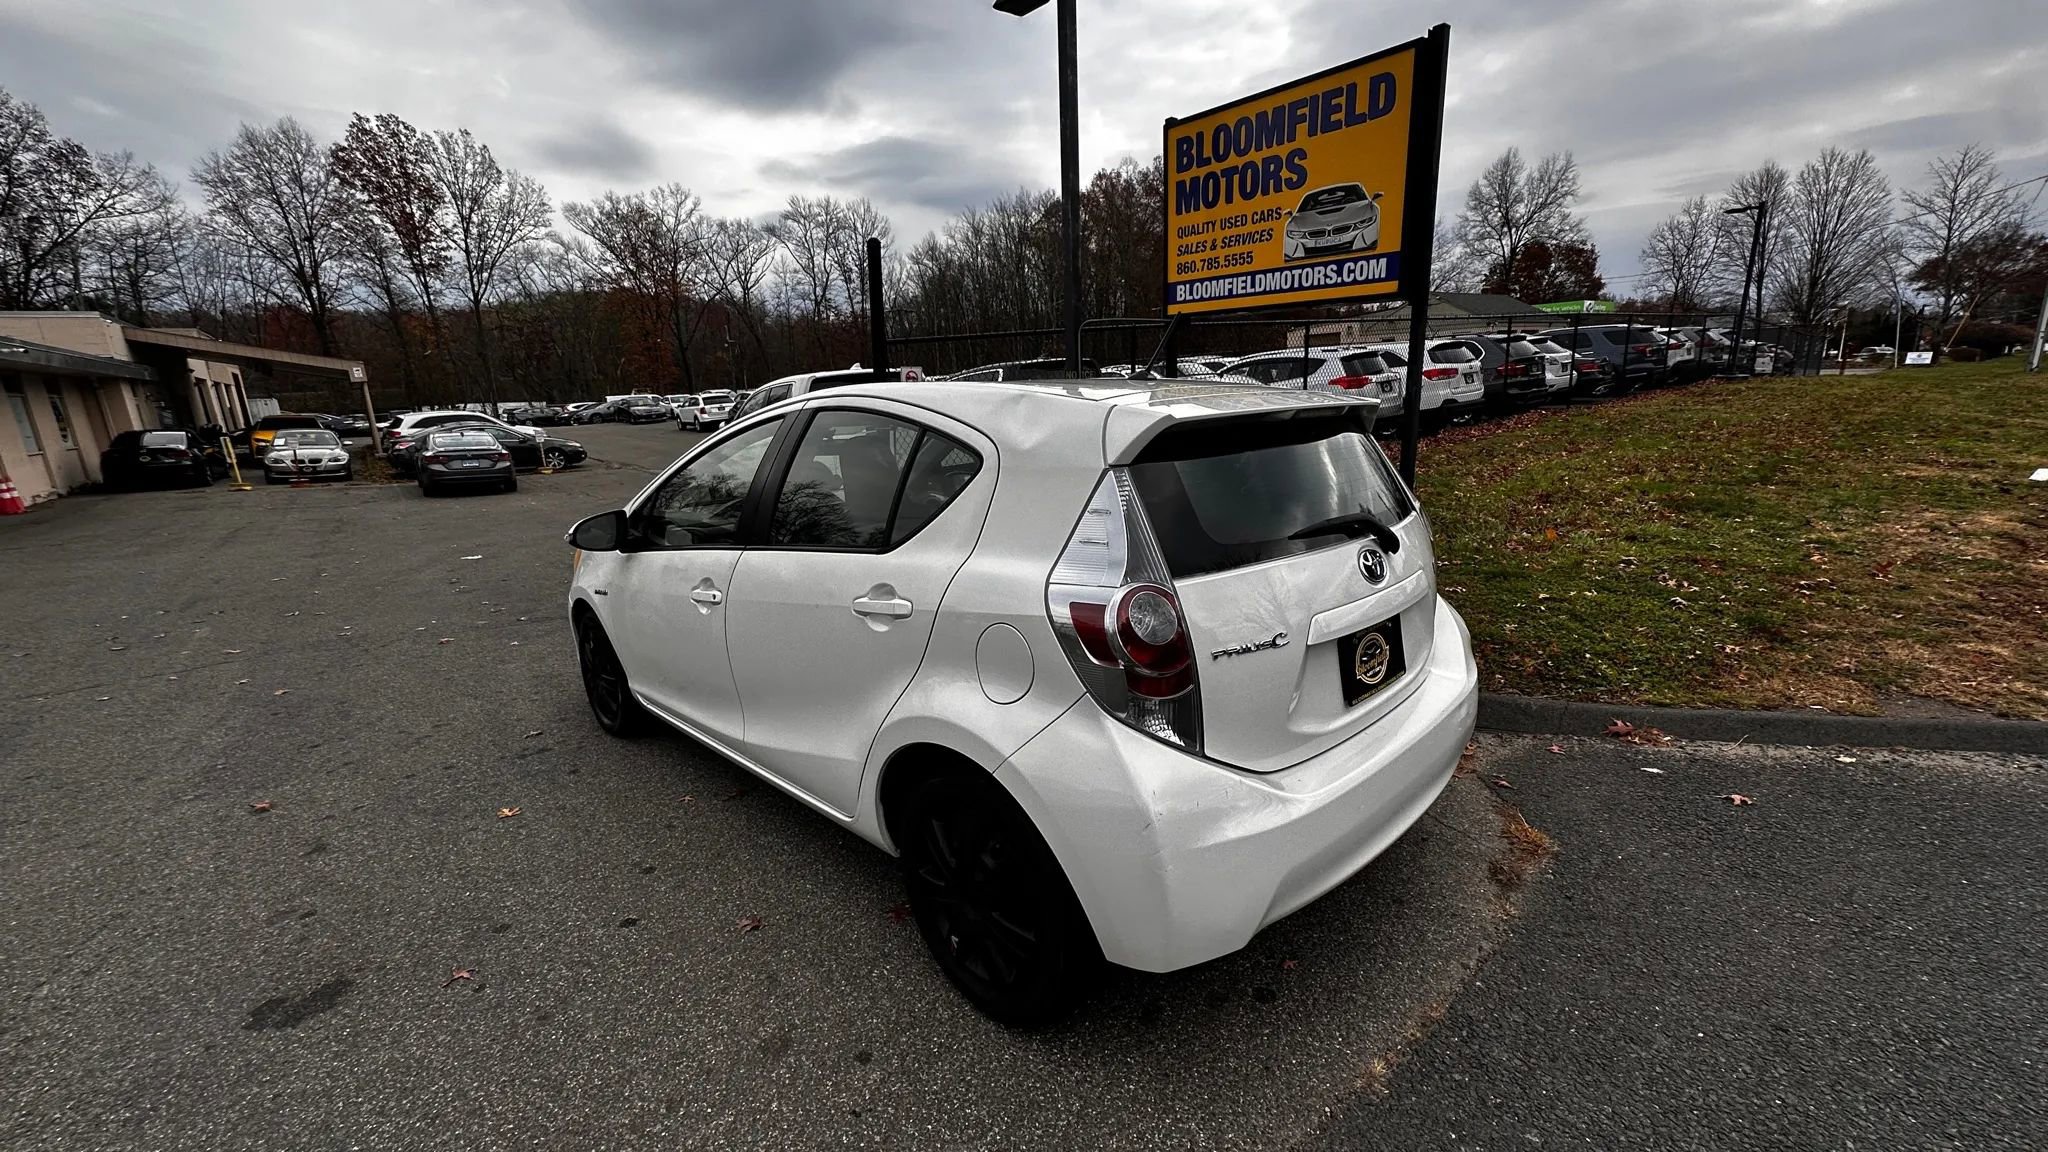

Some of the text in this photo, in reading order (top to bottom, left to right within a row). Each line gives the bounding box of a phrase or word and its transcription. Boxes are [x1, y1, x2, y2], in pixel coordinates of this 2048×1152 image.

[1175, 71, 1397, 174] BLOOMFIELD
[1175, 147, 1308, 216] MOTORS
[1177, 206, 1283, 240] QUALITY USED CARS
[1176, 228, 1274, 257] SALES & SERVICES
[1176, 250, 1254, 275] 860.785.5555
[1176, 257, 1388, 302] BLOOMFIELDMOTORS.COM
[1065, 371, 1094, 379] NOICE
[1211, 640, 1273, 662] PRIUS
